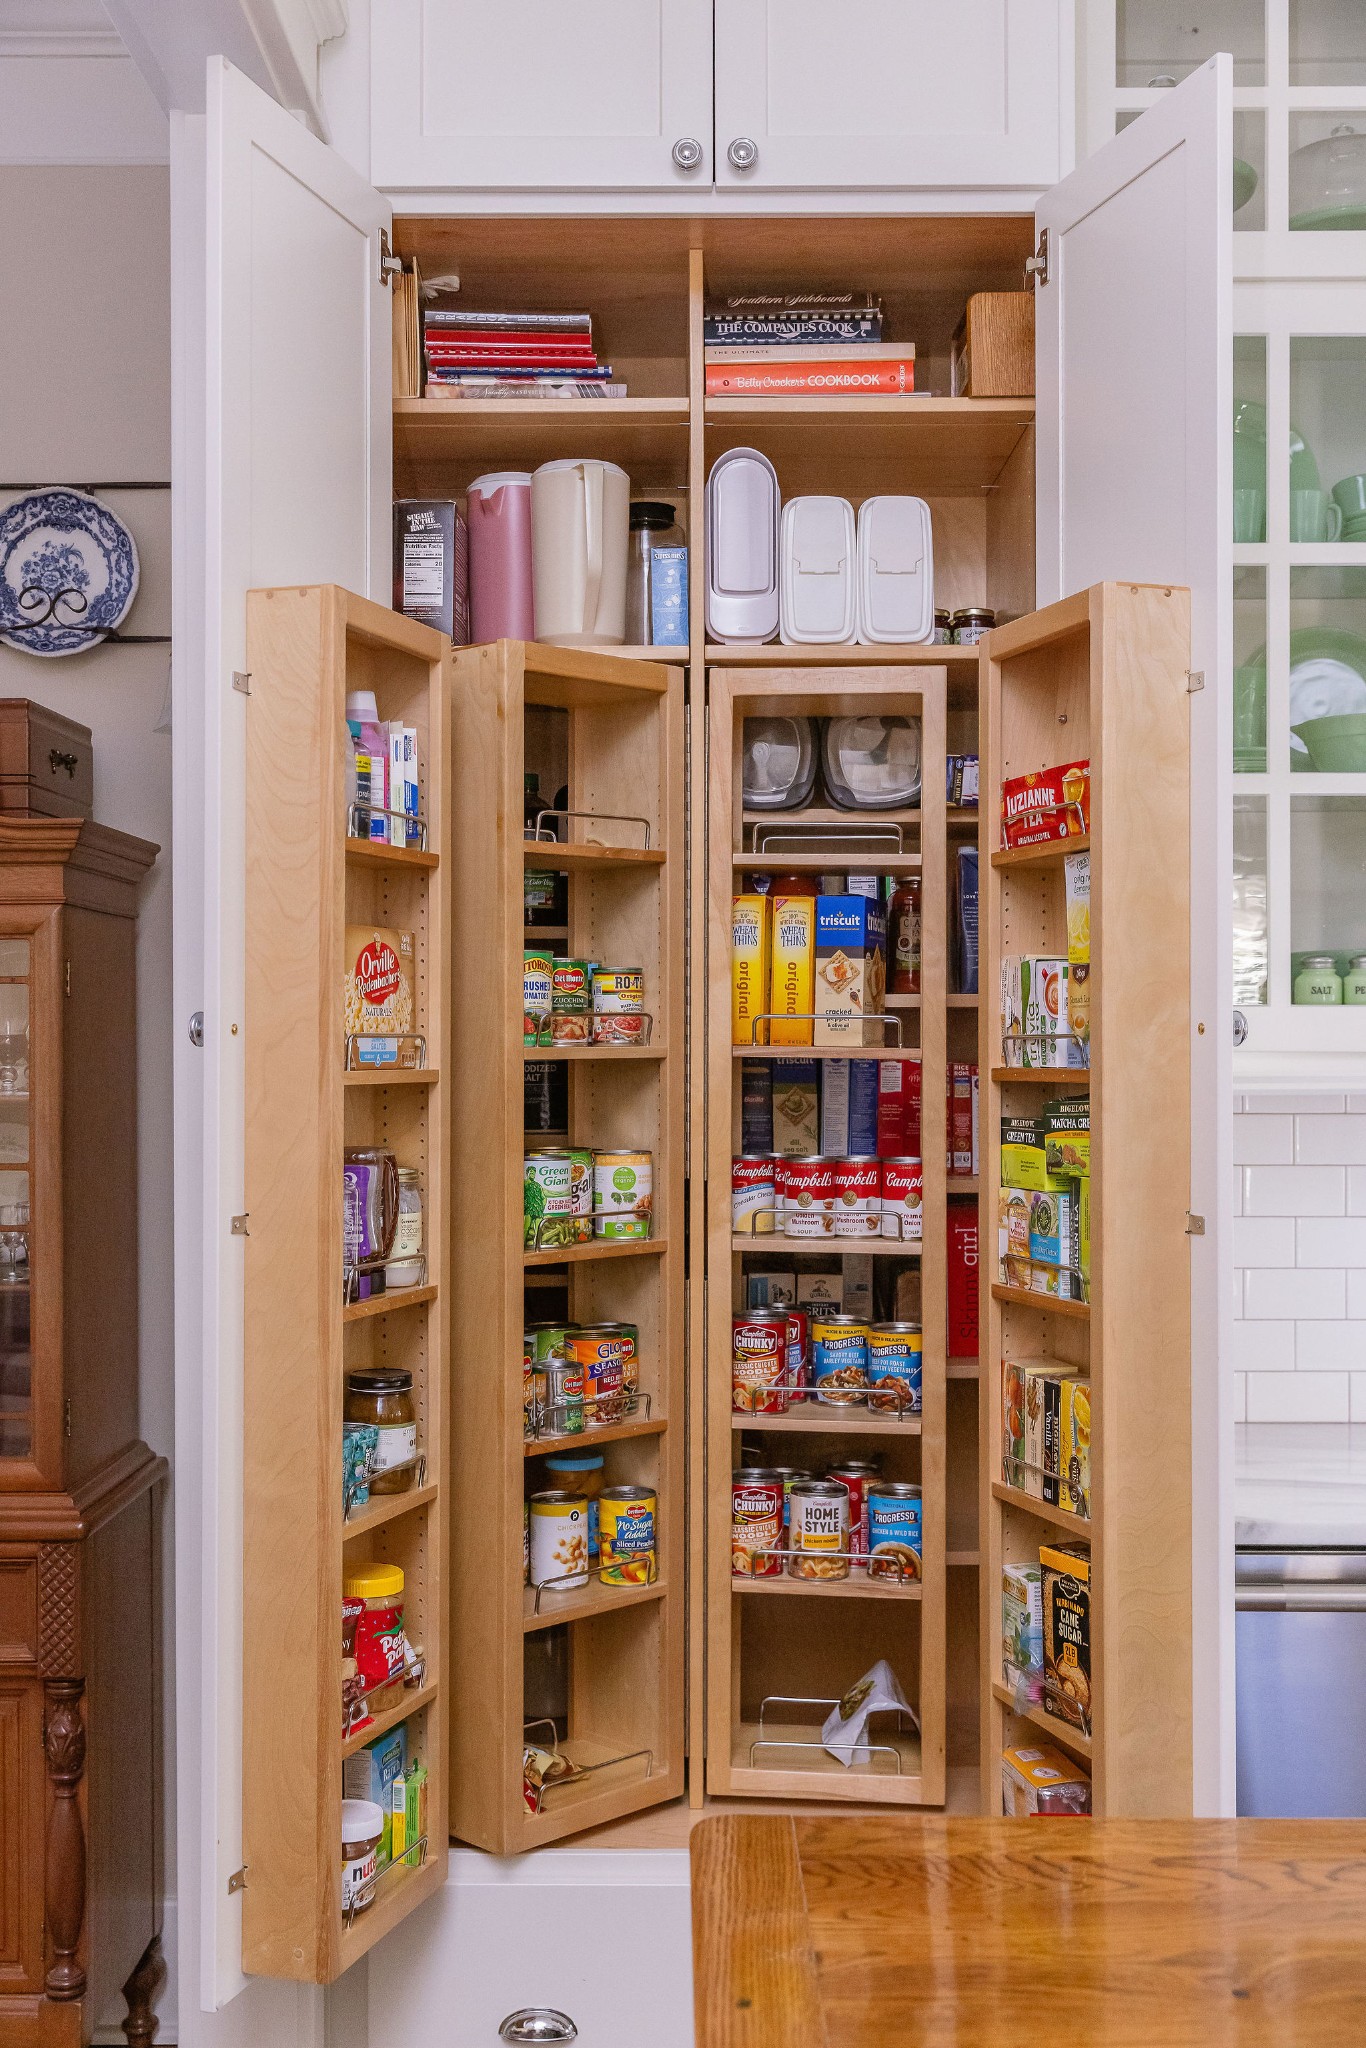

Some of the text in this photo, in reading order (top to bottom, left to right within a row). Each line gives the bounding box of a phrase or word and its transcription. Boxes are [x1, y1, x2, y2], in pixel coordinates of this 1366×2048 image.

[728, 295, 783, 307] Southern
[435, 314, 508, 322] BRANDON
[716, 321, 855, 335] THE COMPANIES COOK
[735, 375, 881, 388] Betty Crocker's COOKBOOK
[1006, 788, 1056, 822] LUZIANNE
[820, 914, 860, 926] triscuit
[780, 926, 807, 936] WHEAT
[361, 948, 395, 979] Orville
[356, 969, 401, 999] Redenbacher's
[736, 961, 751, 1020] original
[1311, 986, 1333, 995] SALT
[365, 1007, 393, 1017] NATURALS
[1051, 1119, 1077, 1129] MATCHA
[1006, 1131, 1036, 1143] GREEN TEA
[539, 1166, 569, 1176] Green
[785, 1171, 832, 1189] Campbell's
[834, 1170, 877, 1187] ampbell's
[955, 1227, 979, 1266] girl
[960, 1268, 979, 1339] Skinny
[806, 1306, 836, 1317] GRITS
[735, 1335, 774, 1349] CHUNKY
[825, 1337, 864, 1350] PROGRESSO
[871, 1346, 907, 1357] PROGRESSO
[754, 1360, 777, 1368] CHICKEN
[888, 1366, 917, 1374] VEGETABLES
[734, 1366, 778, 1376] NOODLE
[734, 1499, 774, 1512] CHUNKY
[805, 1508, 839, 1520] HOME
[875, 1511, 915, 1524] PROGRESSO
[617, 1520, 653, 1531] No Sugar
[755, 1522, 777, 1531] CHICKEN
[805, 1521, 839, 1533] STYLE
[624, 1531, 648, 1539] Added
[733, 1528, 777, 1539] NOODLE
[872, 1528, 888, 1536] CHICKEN
[616, 1540, 636, 1548] Sliced
[1060, 1608, 1080, 1629] CANE
[1058, 1622, 1083, 1645] SUGAR
[383, 1761, 401, 1782] Ranch
